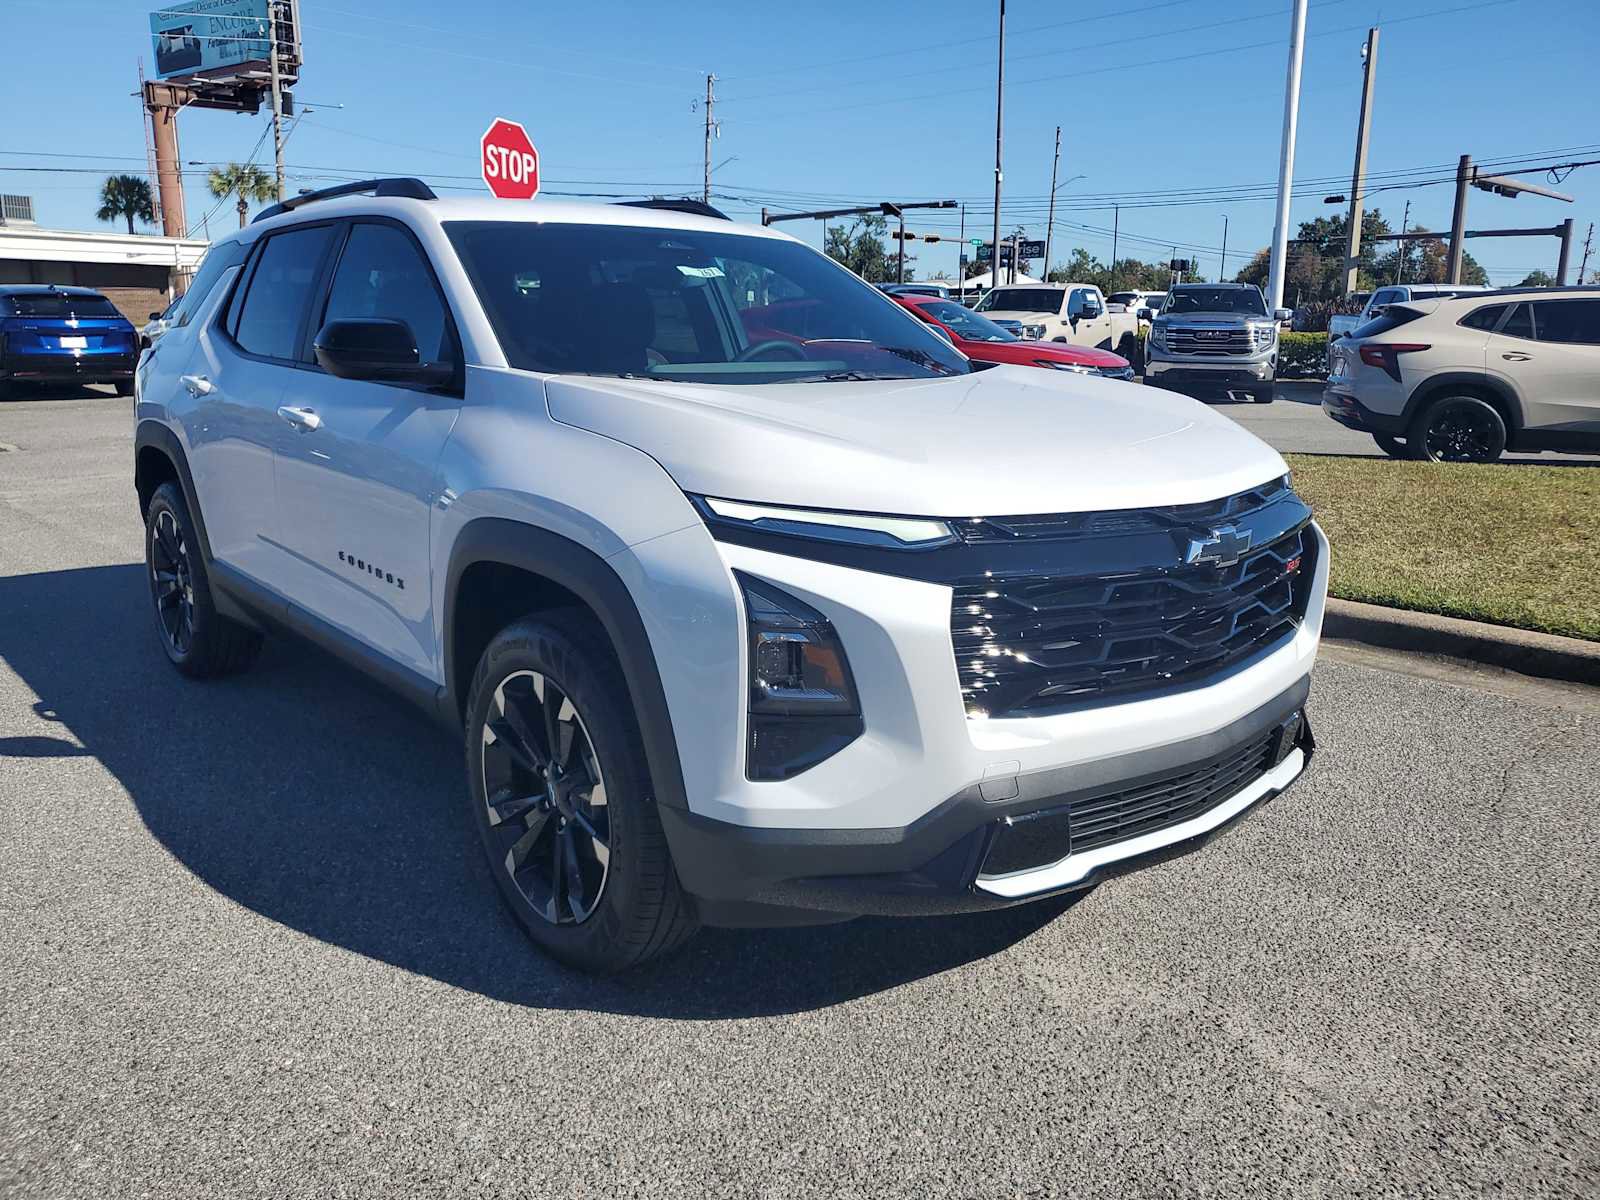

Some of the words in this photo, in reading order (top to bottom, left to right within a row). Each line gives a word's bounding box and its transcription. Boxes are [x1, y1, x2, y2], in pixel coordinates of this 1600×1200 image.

[209, 9, 255, 33] ENCORE
[486, 144, 535, 185] STOP
[1195, 331, 1230, 339] GMC
[338, 551, 405, 590] EQUINOX
